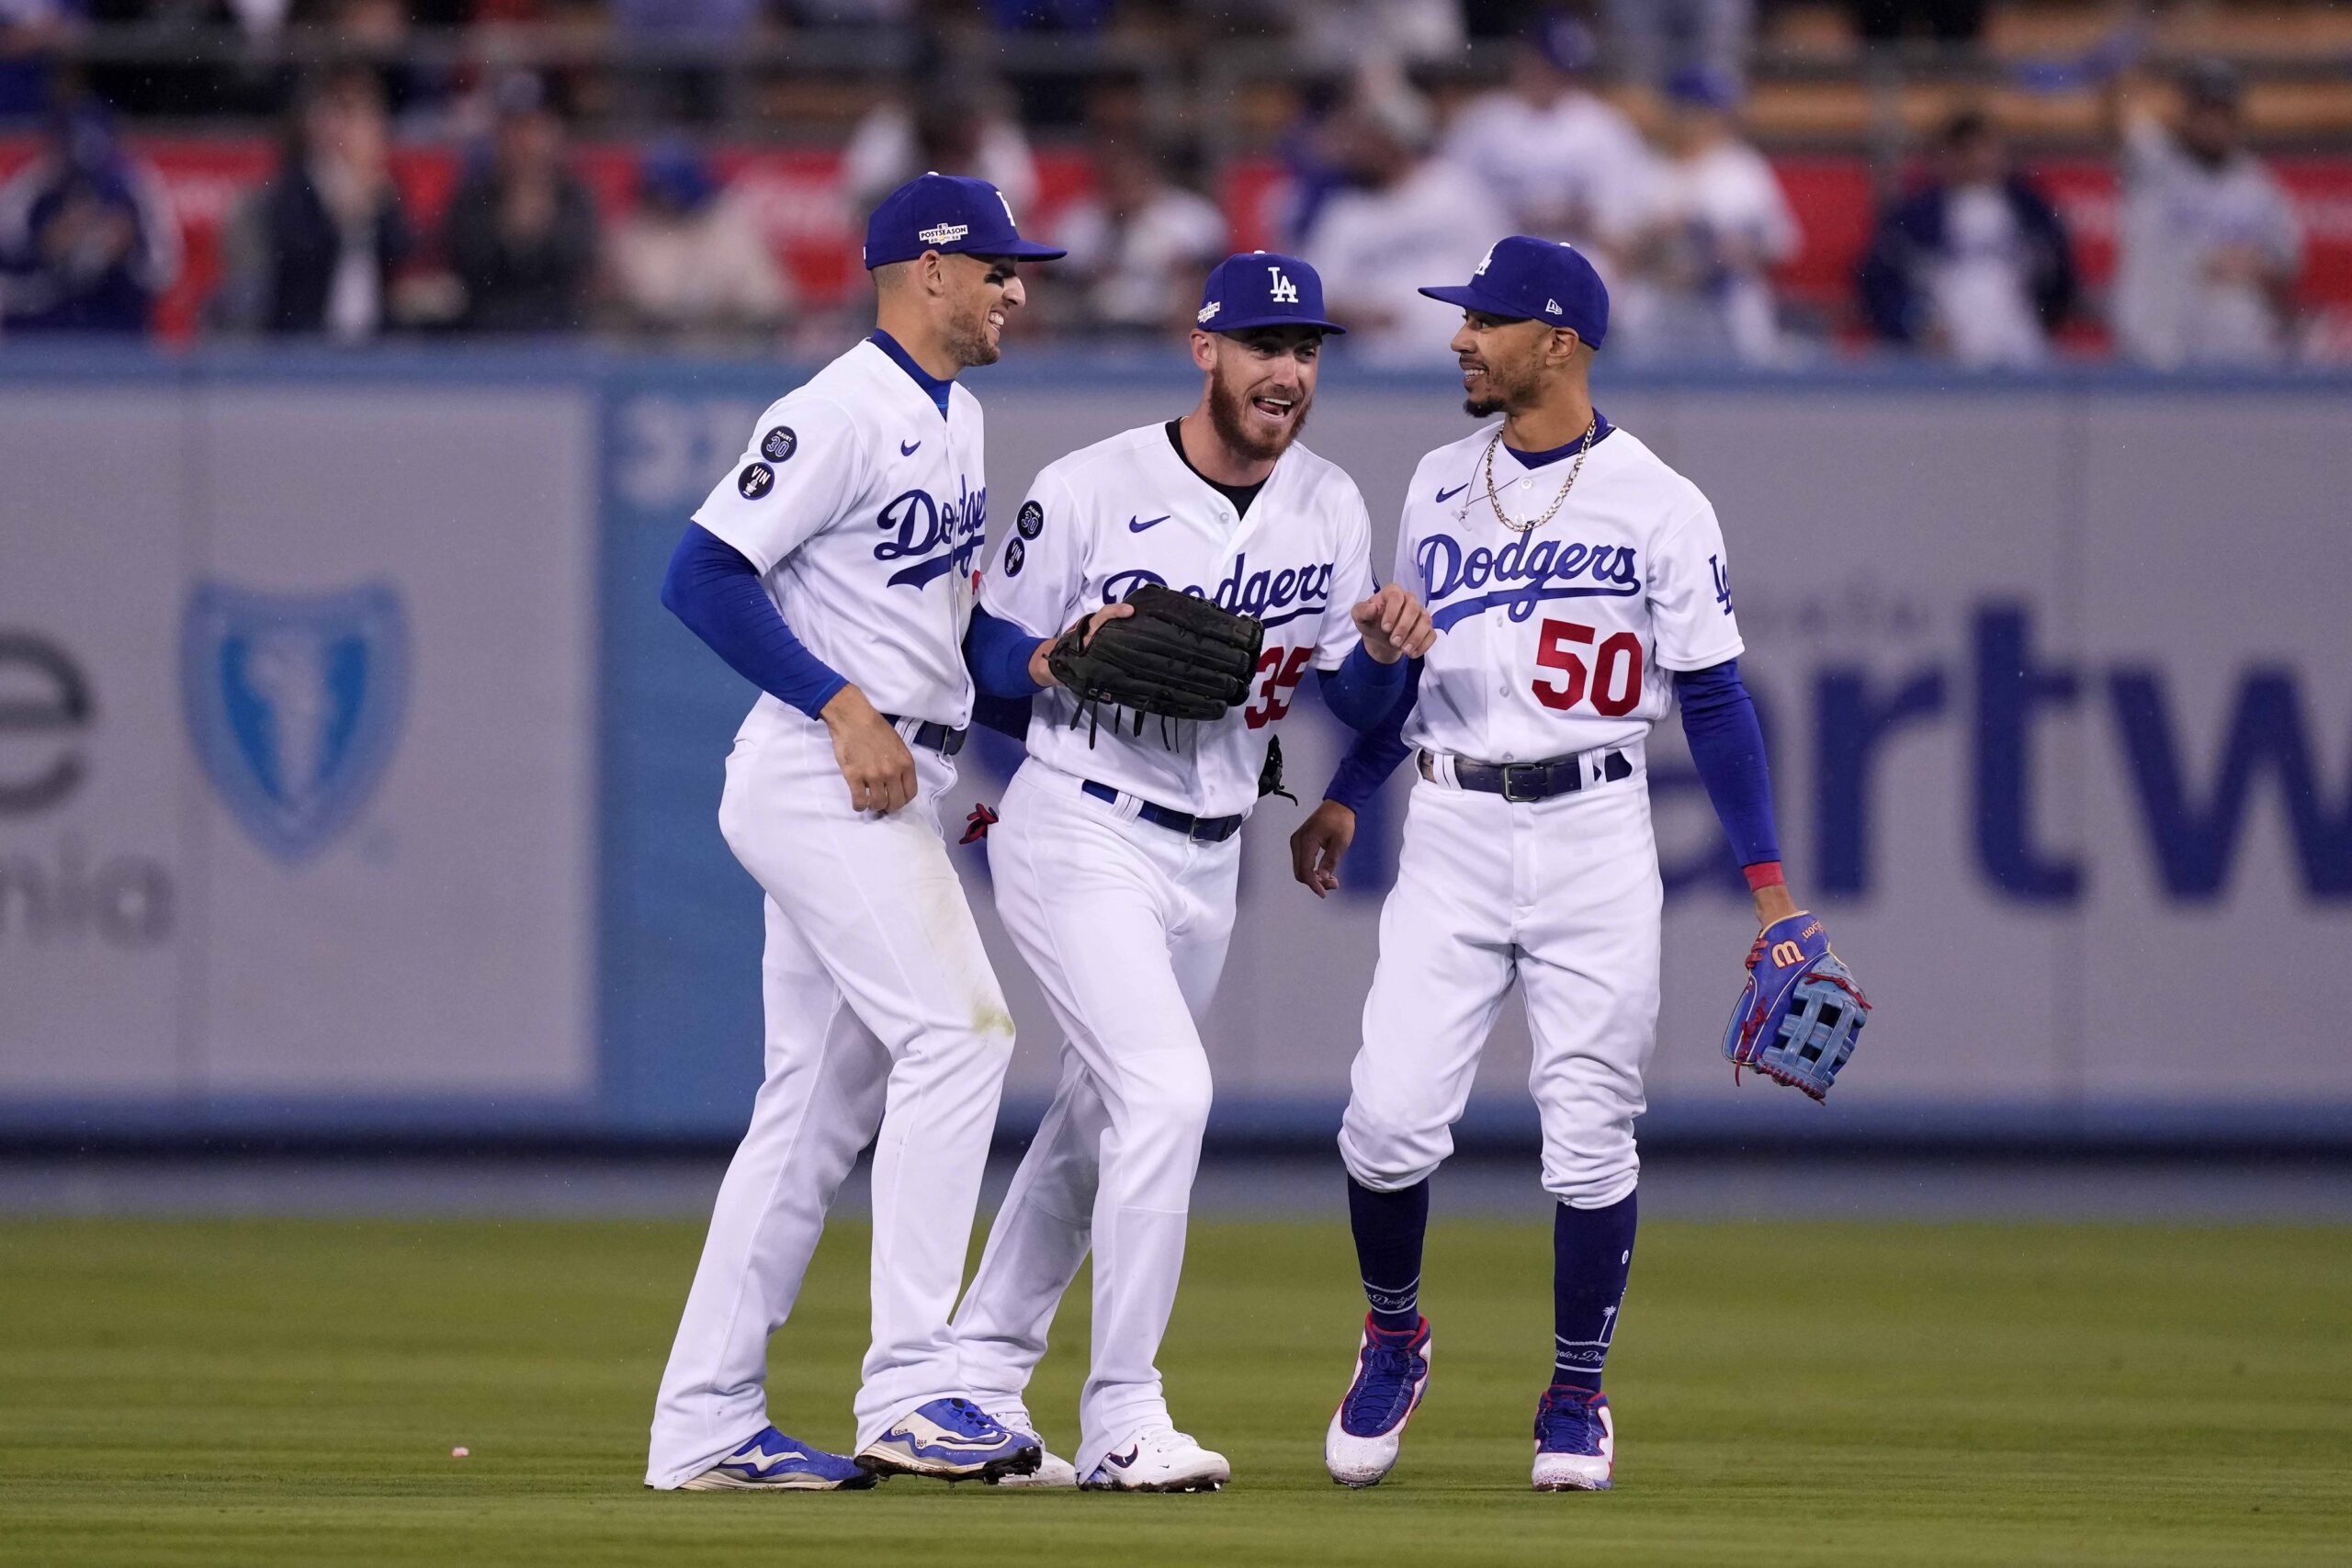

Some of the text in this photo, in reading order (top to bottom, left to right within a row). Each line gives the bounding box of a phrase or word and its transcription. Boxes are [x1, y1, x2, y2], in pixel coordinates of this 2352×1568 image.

[921, 227, 967, 239] POSTSEASON
[1267, 266, 1299, 303] LA
[766, 435, 790, 457] 30
[776, 430, 793, 442] MAURY
[752, 465, 771, 485] VIN
[874, 474, 986, 582] Dodge
[1021, 510, 1039, 535] 30
[1012, 541, 1022, 561] VIN
[1417, 521, 1641, 628] Dodgers
[1532, 618, 1643, 716] 50
[1244, 647, 1315, 729] 35
